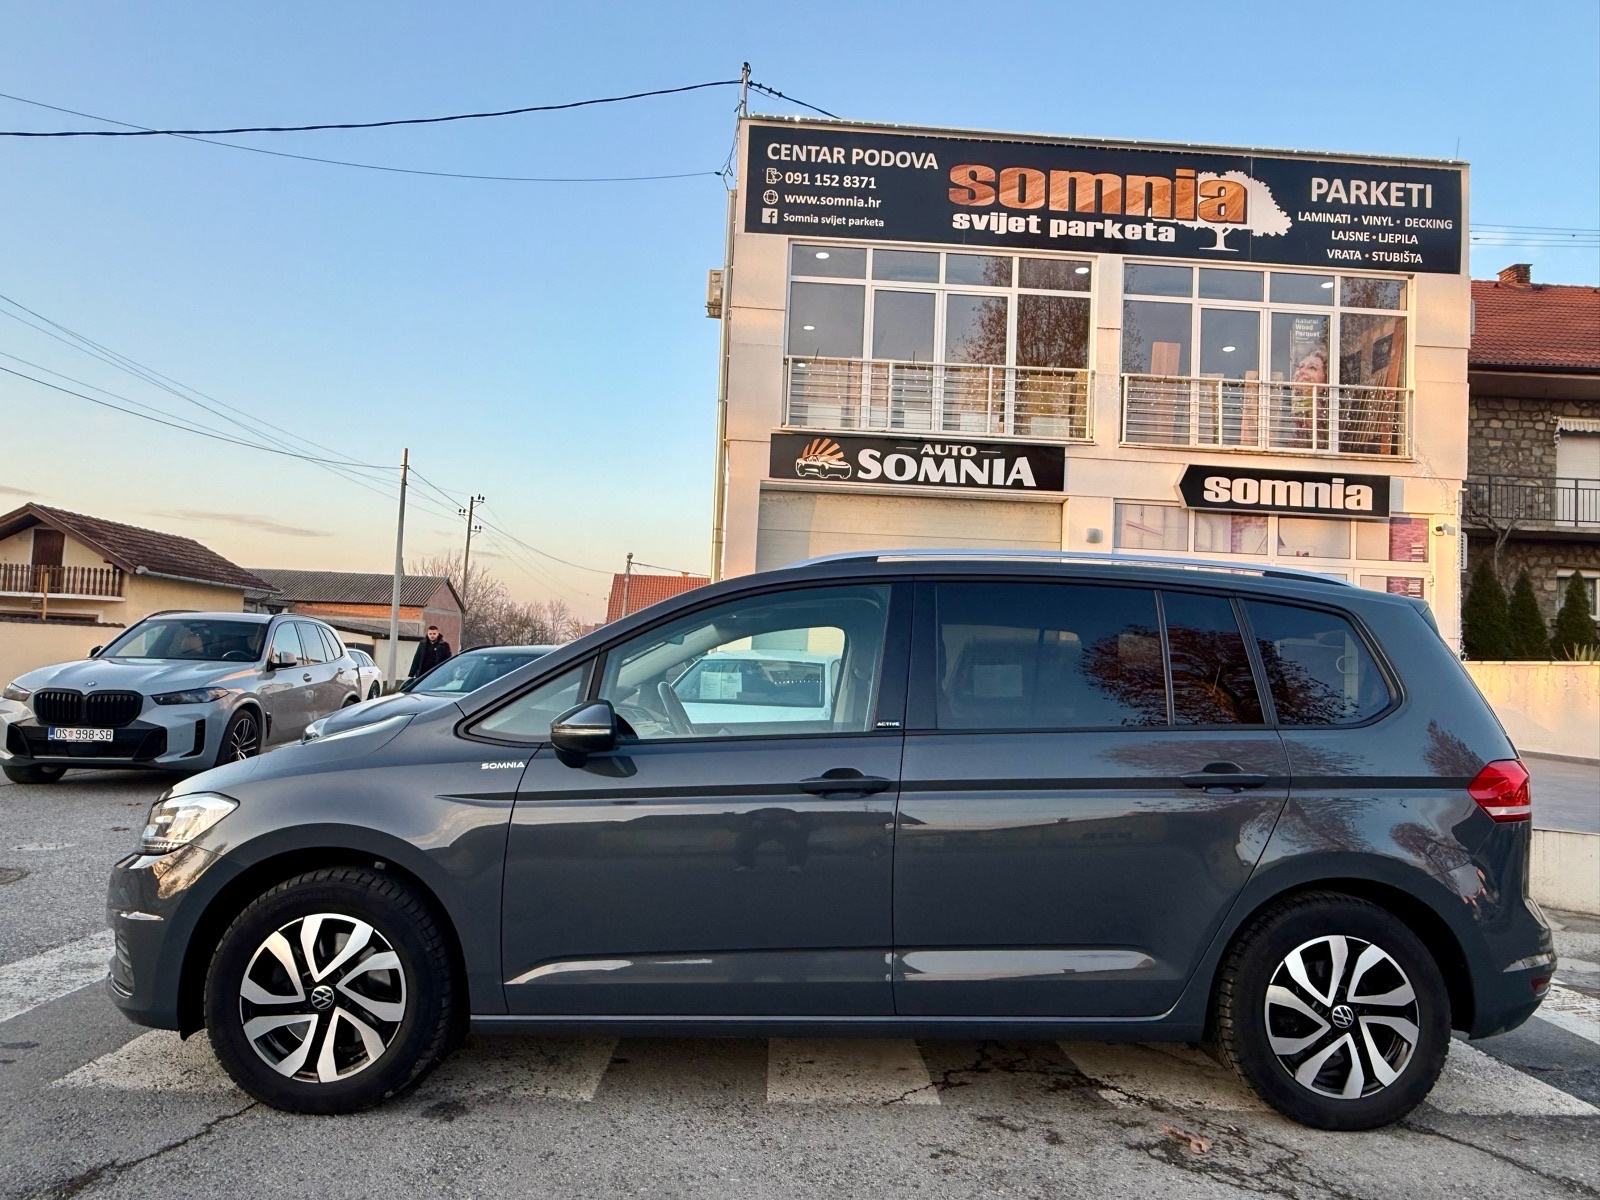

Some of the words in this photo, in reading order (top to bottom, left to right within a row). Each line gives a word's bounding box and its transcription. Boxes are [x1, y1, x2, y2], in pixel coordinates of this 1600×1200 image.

[767, 143, 846, 164] CENTAR
[851, 148, 939, 170] PODOVA
[785, 172, 811, 185] 091
[814, 173, 840, 187] 152
[843, 175, 877, 189] 8371
[784, 194, 882, 209] www.somnia.hr
[948, 164, 1247, 224] somnia
[1311, 177, 1433, 209] PARKETI
[783, 212, 819, 224] Somnia
[820, 215, 846, 227] svijet
[848, 216, 885, 227] parketa
[952, 212, 1042, 235] svijet
[1049, 218, 1176, 243] parketa
[1298, 211, 1351, 224] LAMINATI
[1361, 215, 1394, 227] VINYL
[1404, 217, 1453, 230] DECKING
[1331, 230, 1370, 242] LAJSNE
[1378, 232, 1418, 245] LJEPILA
[1326, 248, 1362, 261] VRATA
[1372, 250, 1423, 264] STUBIŠTA
[920, 443, 977, 457] AUTO
[857, 448, 1037, 487] SOMNIA
[1203, 476, 1373, 511] somnia
[480, 761, 526, 770] SOMNIA
